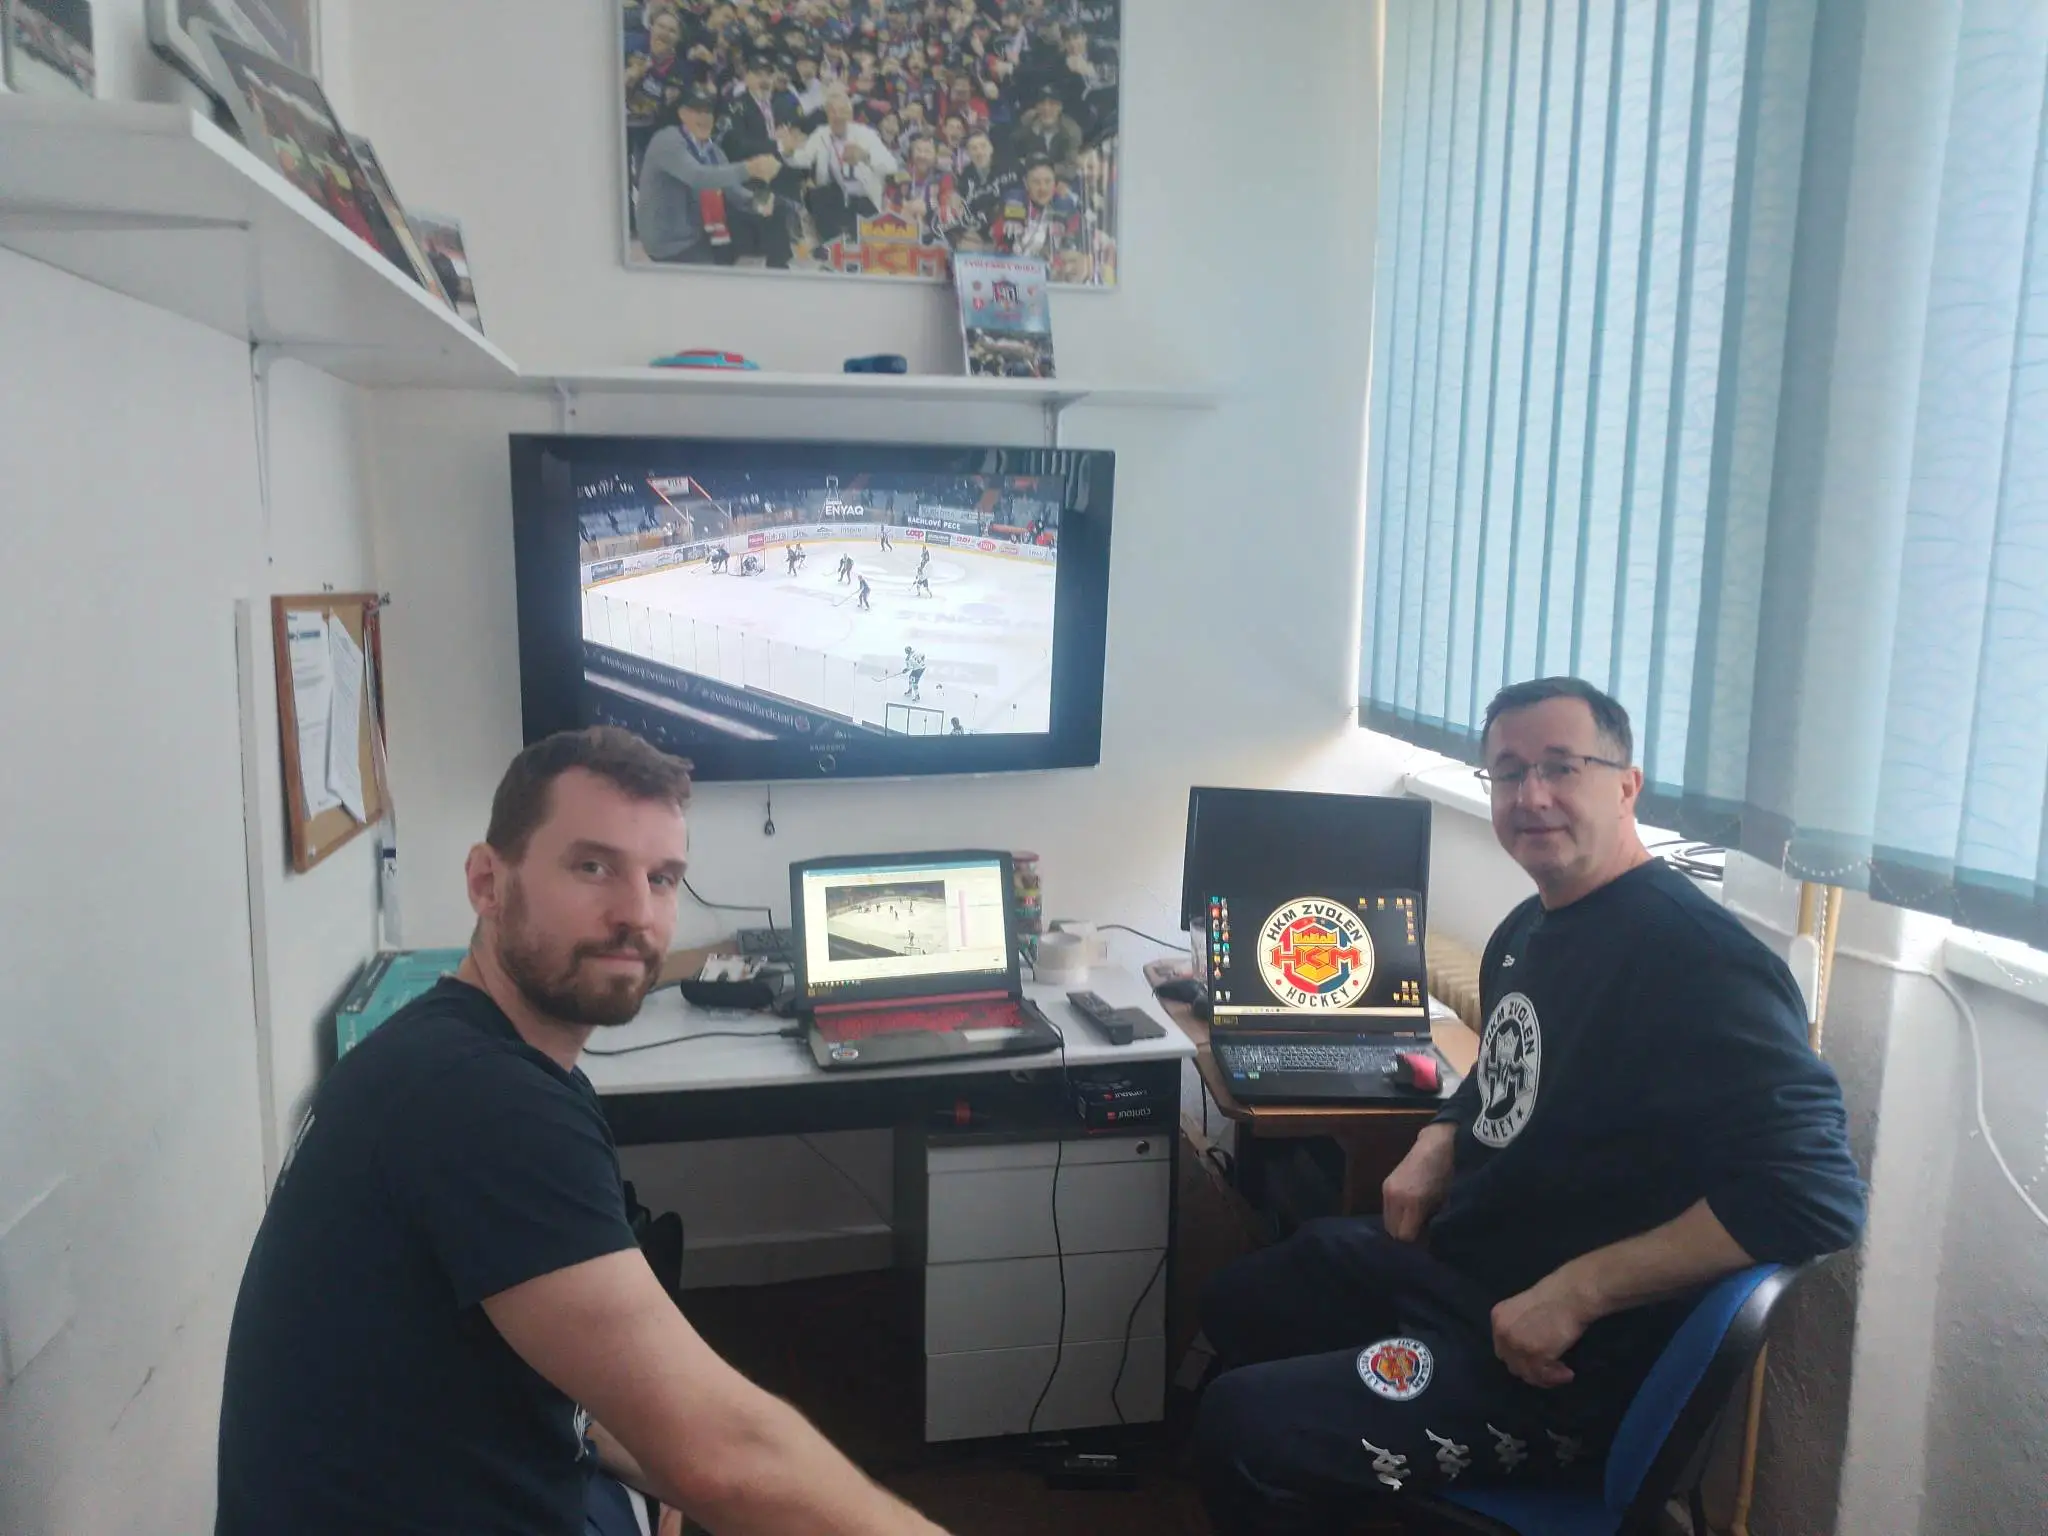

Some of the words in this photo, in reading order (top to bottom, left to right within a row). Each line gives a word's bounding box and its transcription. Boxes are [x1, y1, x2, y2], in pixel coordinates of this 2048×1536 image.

[825, 505, 865, 517] ENYAQ
[1266, 909, 1297, 942] HKM
[1301, 903, 1364, 943] ZVOLEN
[1285, 985, 1352, 1007] HOCKEY
[1484, 1005, 1505, 1045] HKM
[1507, 1000, 1537, 1056] ZVOLEN
